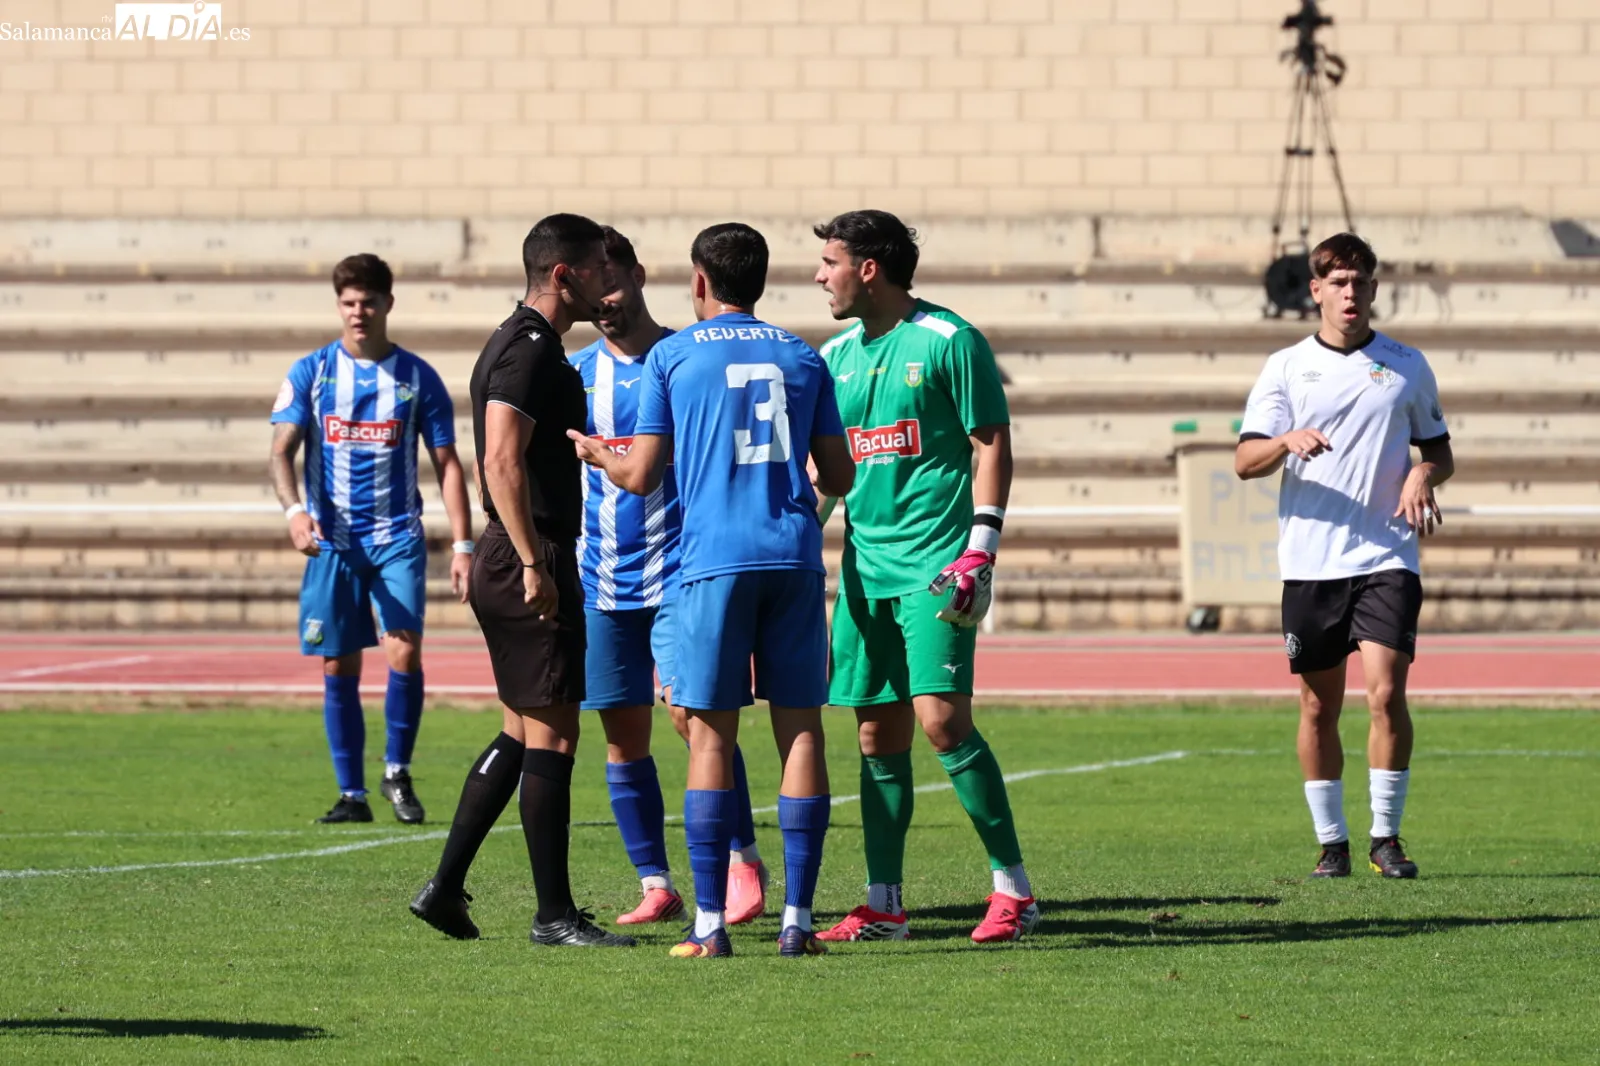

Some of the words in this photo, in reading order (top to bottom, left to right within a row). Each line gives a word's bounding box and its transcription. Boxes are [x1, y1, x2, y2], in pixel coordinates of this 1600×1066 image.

[693, 327, 789, 343] REVERTE
[726, 363, 790, 464] 3
[328, 420, 398, 441] Pascual
[854, 425, 913, 454] Pacual
